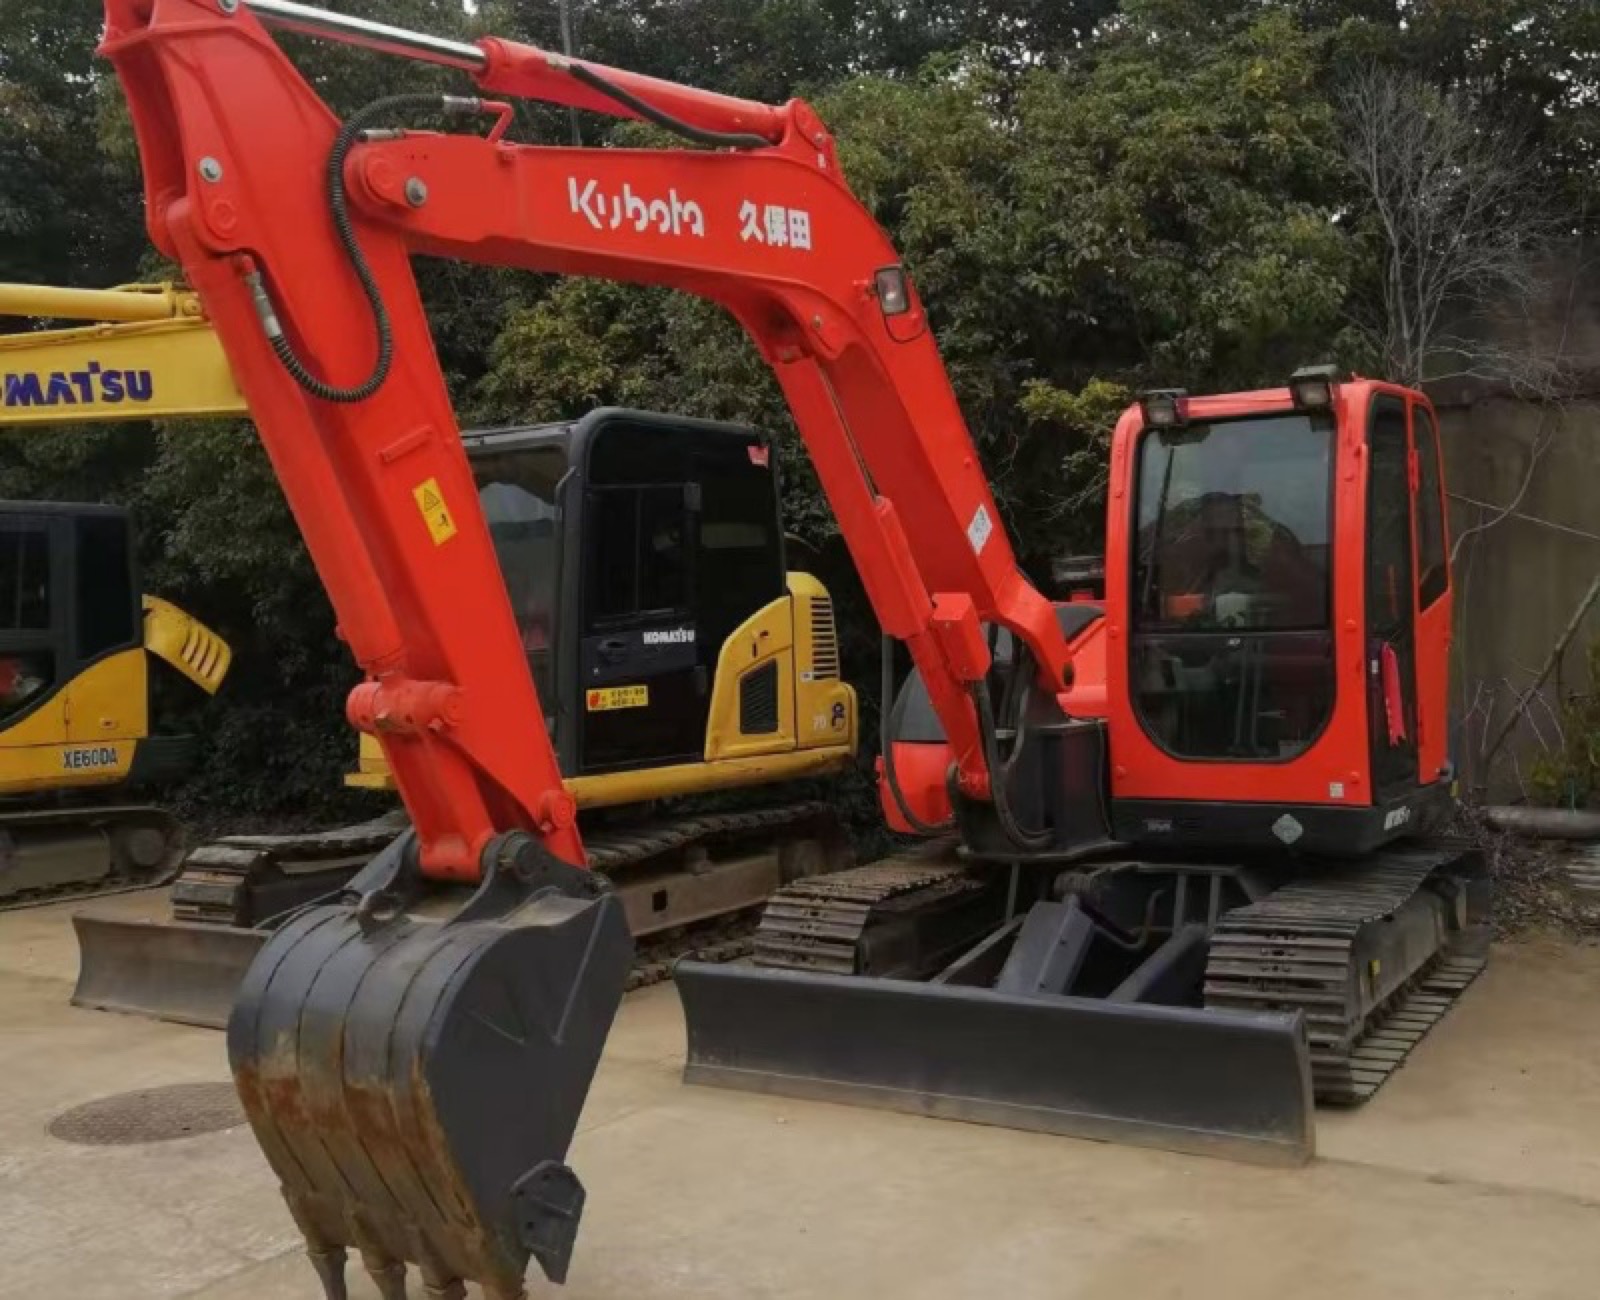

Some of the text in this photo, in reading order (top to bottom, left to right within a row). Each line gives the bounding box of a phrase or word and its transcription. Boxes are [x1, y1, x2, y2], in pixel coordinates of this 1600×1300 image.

[567, 176, 704, 237] Kubota
[738, 199, 811, 250] 久保田
[0, 361, 153, 406] MATSU
[643, 627, 695, 645] KOMATSU
[63, 747, 118, 769] XE60DA
